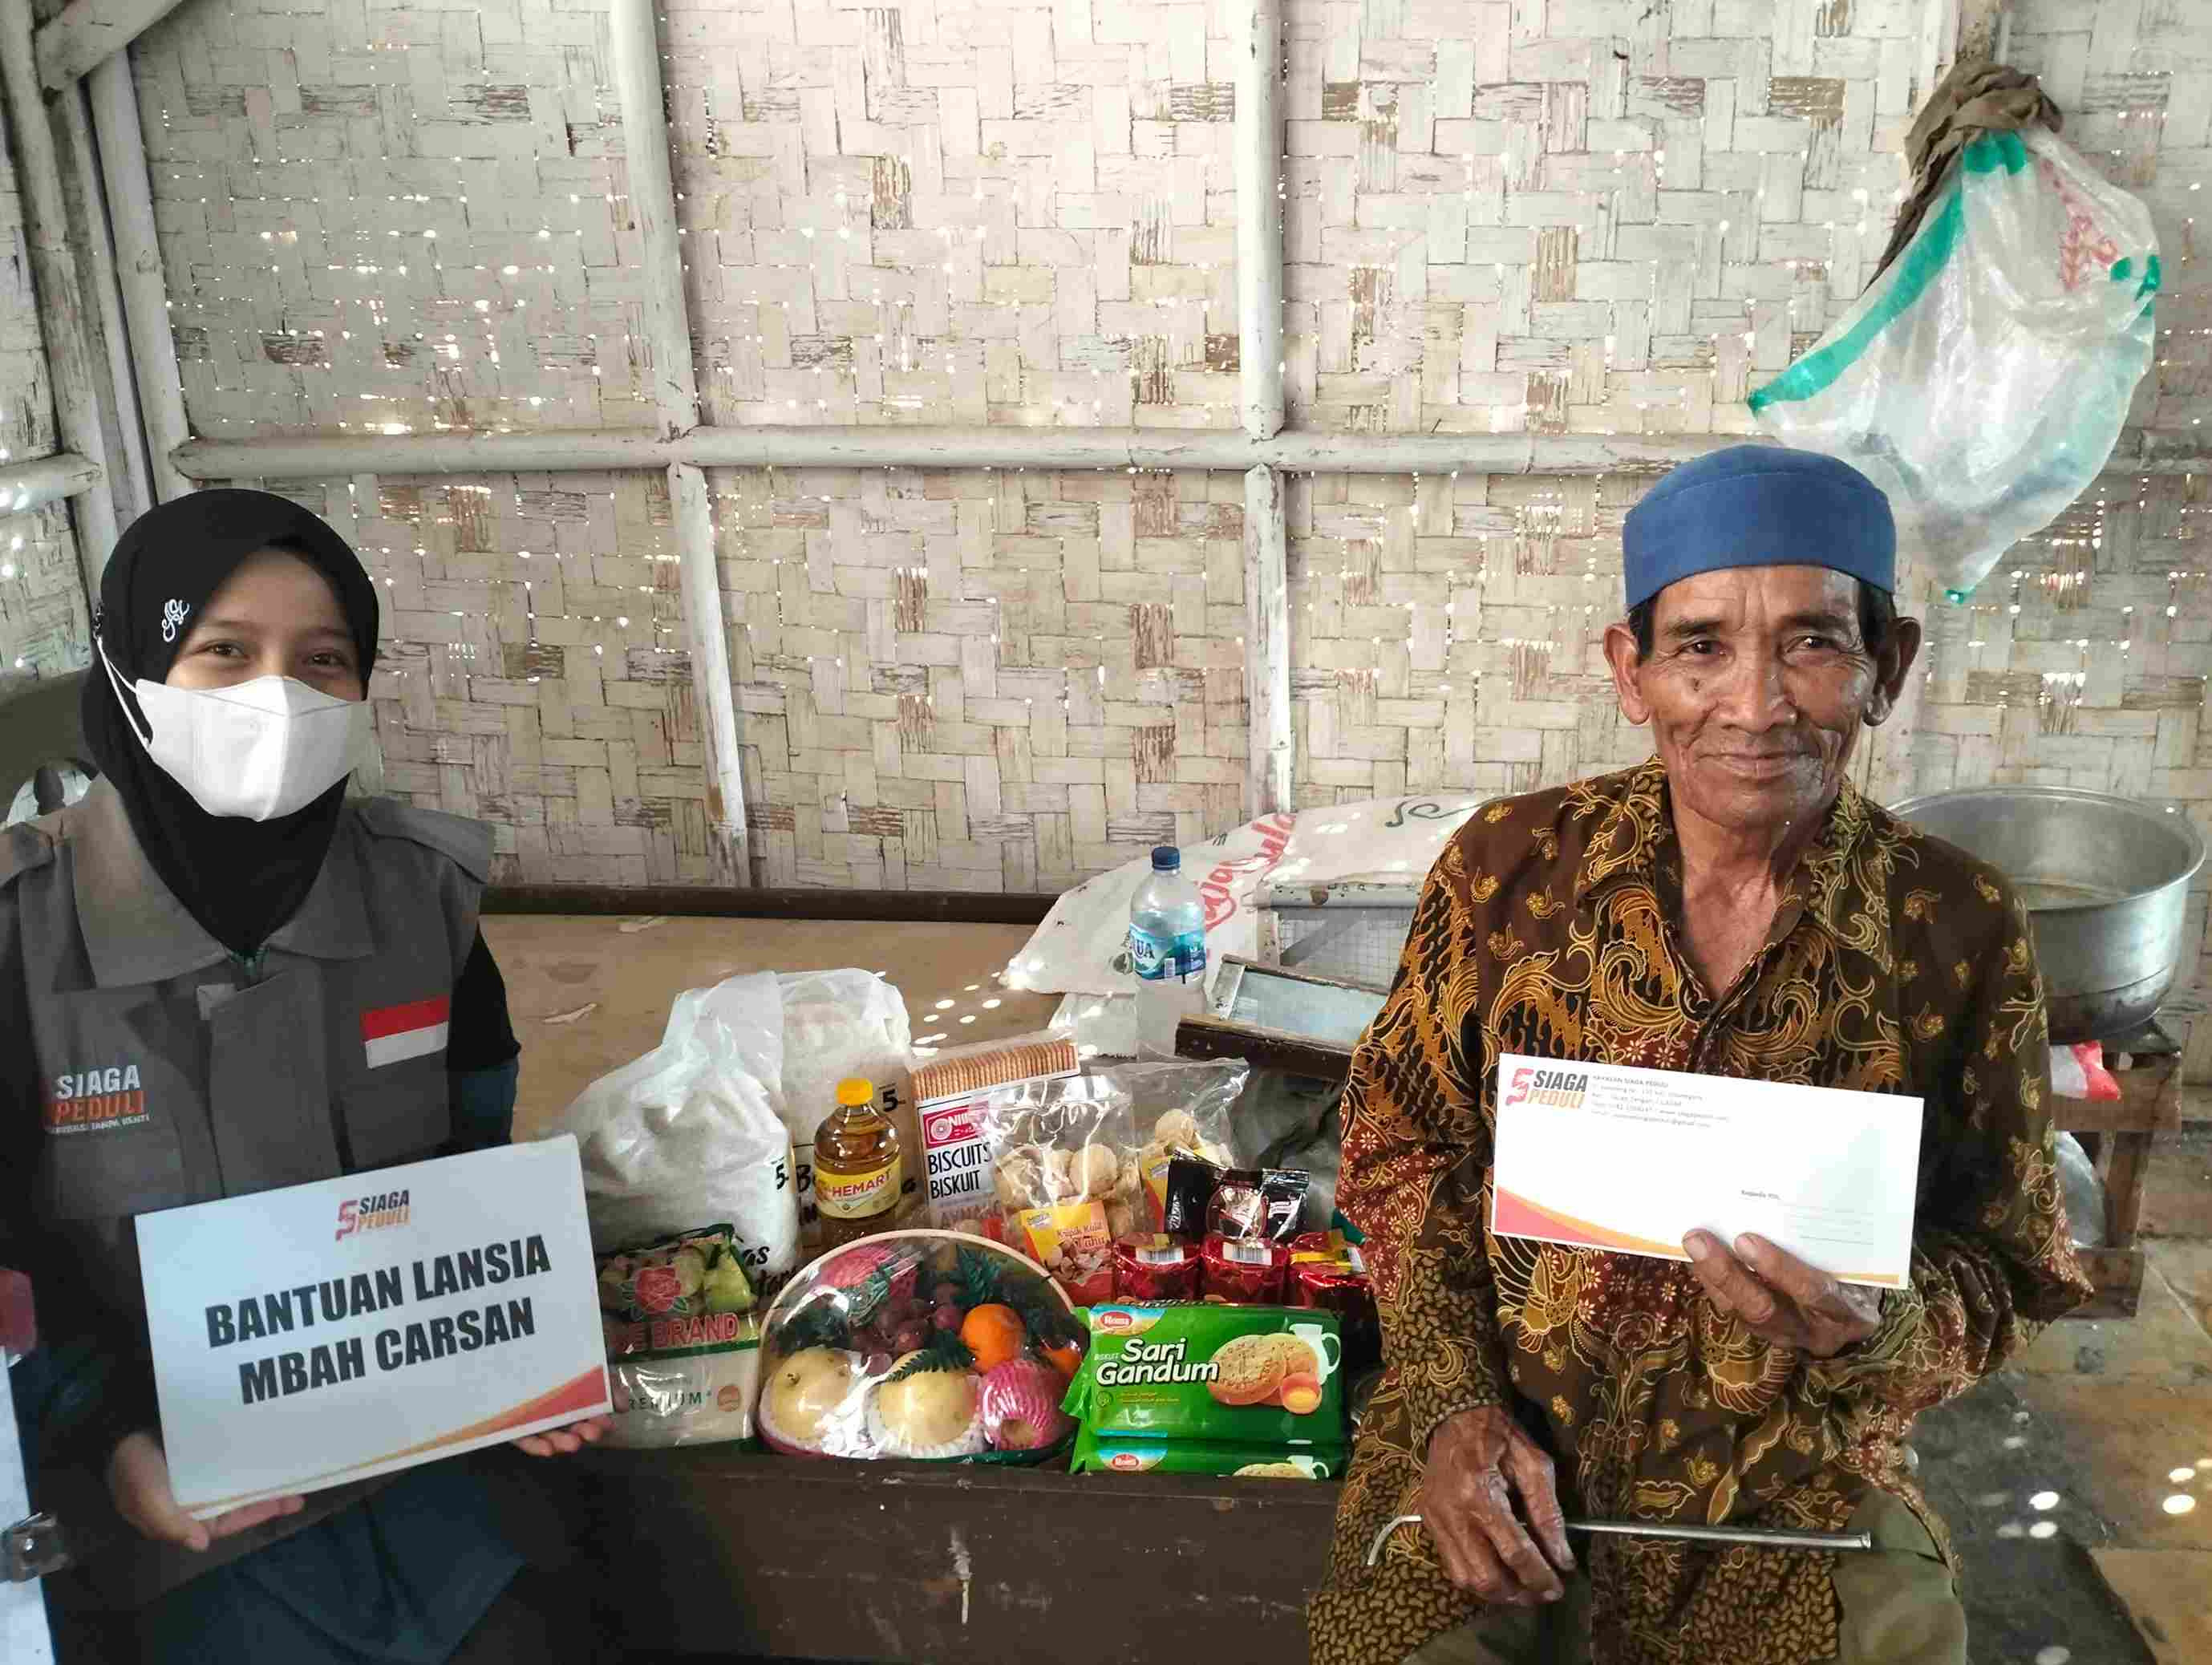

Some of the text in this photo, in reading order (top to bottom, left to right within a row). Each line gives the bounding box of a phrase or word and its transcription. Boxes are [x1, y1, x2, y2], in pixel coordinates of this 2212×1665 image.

[56, 1065, 140, 1100] SIAGA
[1533, 1070, 1589, 1092] SIAGA
[51, 1091, 146, 1127] PEDULI
[1527, 1090, 1586, 1109] PEDULI
[927, 1142, 993, 1175] BISCUITS
[832, 1169, 892, 1197] HEMART
[930, 1169, 981, 1200] BISKUIT
[359, 1189, 410, 1215] SIAGA
[358, 1208, 411, 1230] PEDULI
[205, 1234, 552, 1348] BANTUAN LANSIA
[654, 1311, 739, 1348] BRAND
[238, 1337, 367, 1405] MBAH
[375, 1296, 535, 1371] CARSAN
[1120, 1338, 1187, 1363] Sari
[1096, 1354, 1220, 1386] Gandum
